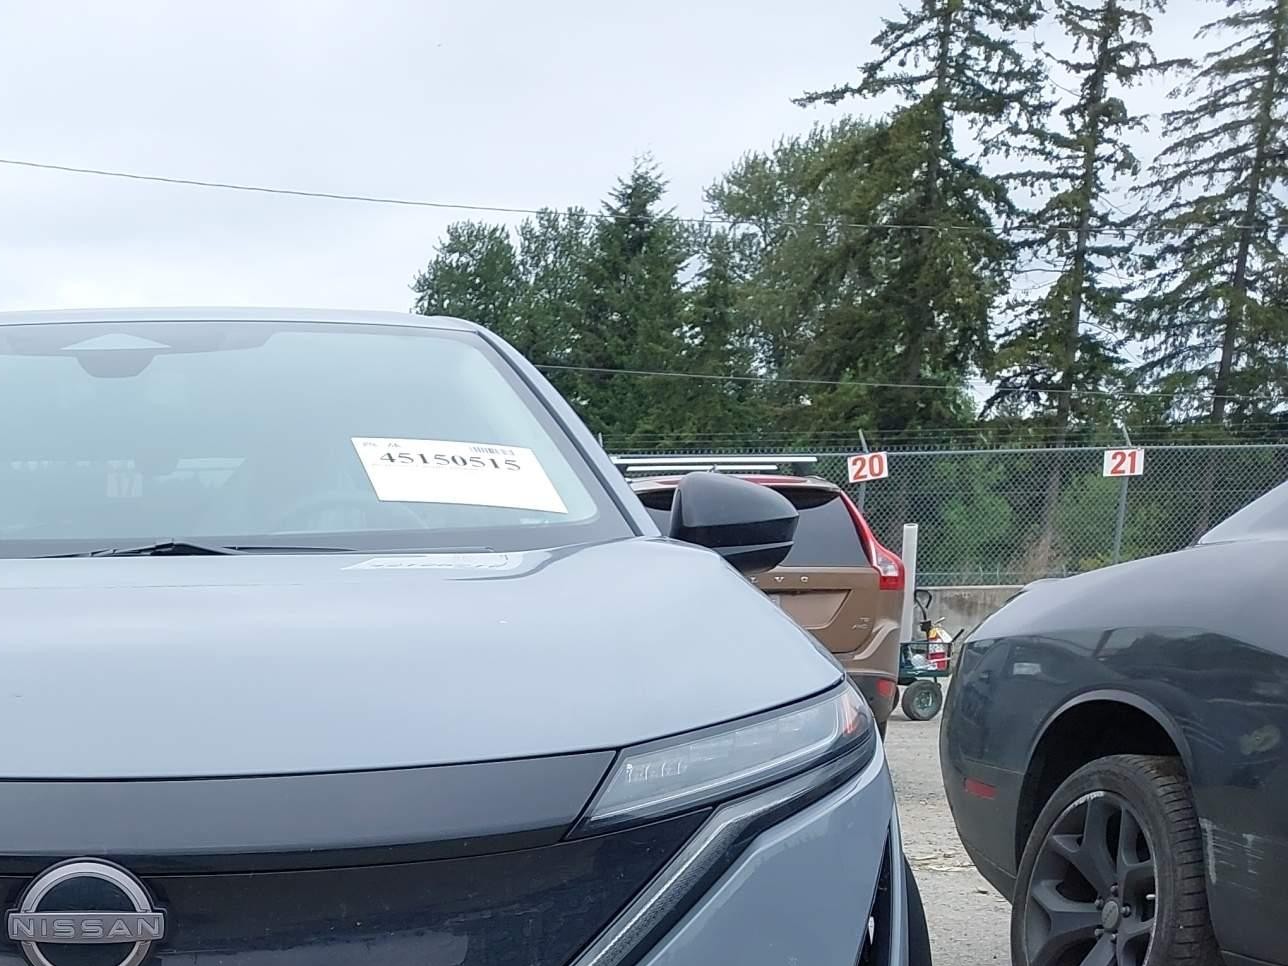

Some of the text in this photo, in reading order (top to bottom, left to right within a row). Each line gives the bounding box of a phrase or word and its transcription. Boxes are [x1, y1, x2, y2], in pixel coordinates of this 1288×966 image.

[380, 451, 521, 471] 45150515
[852, 454, 885, 481] 20
[1109, 450, 1138, 475] 21
[11, 918, 160, 939] NISSAN
